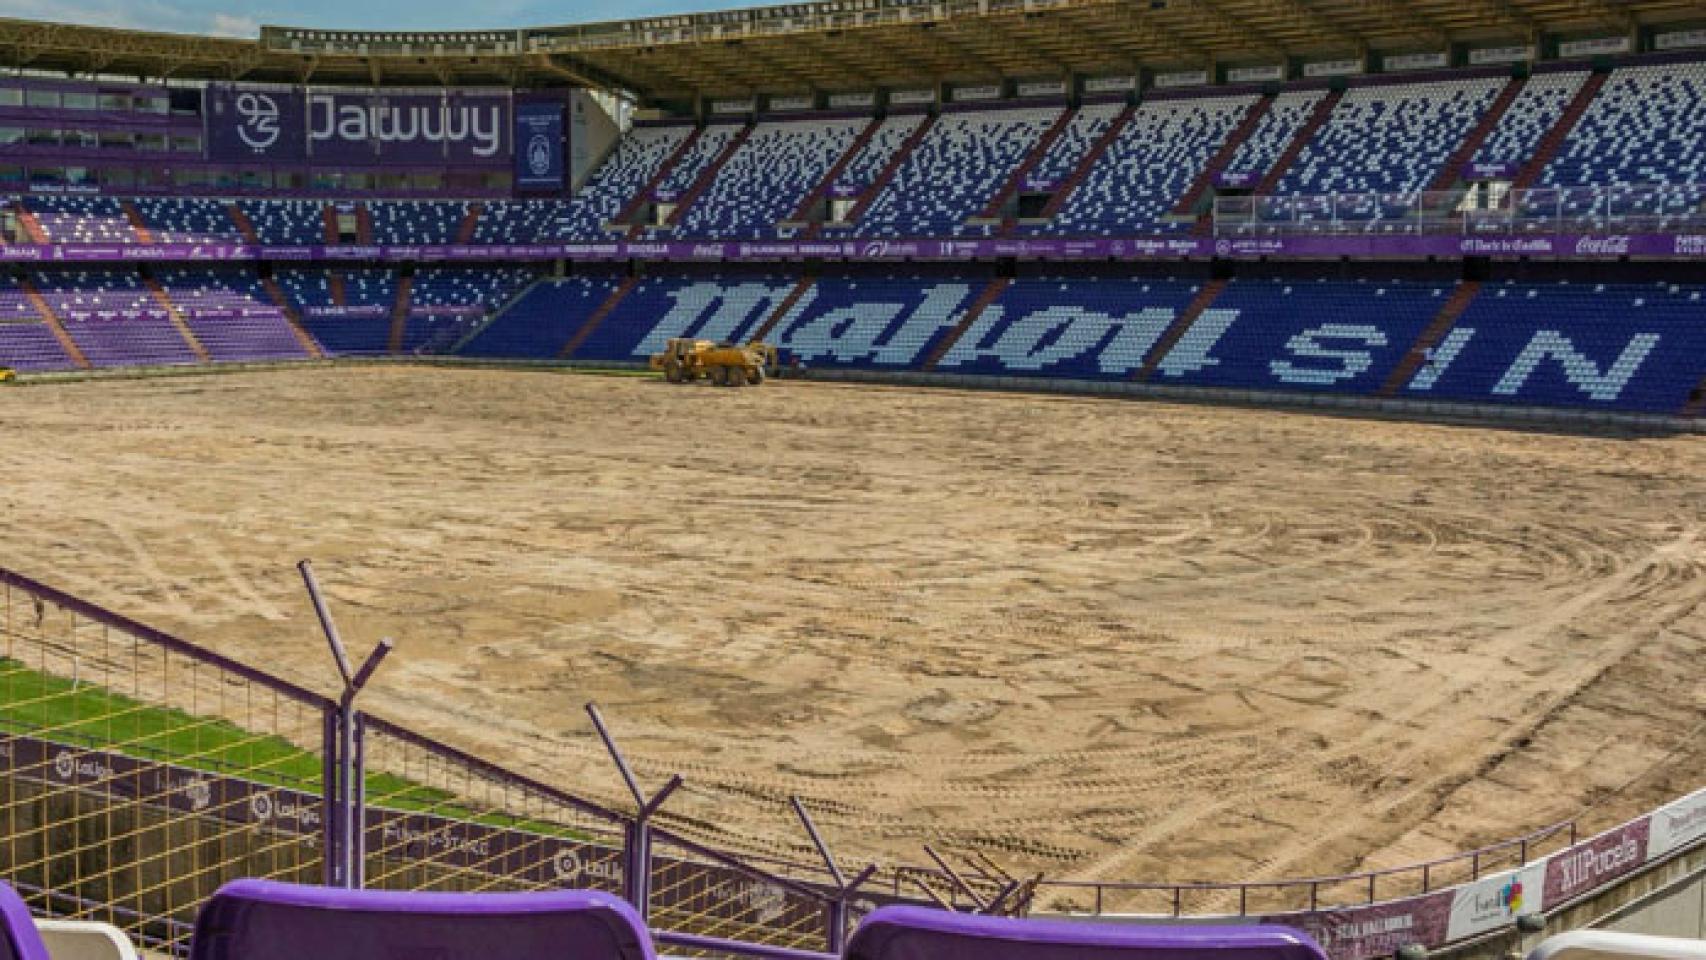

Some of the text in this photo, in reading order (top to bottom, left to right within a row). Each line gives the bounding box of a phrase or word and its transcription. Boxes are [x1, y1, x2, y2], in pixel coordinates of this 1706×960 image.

[309, 94, 500, 156] Jawwy
[630, 282, 1661, 400] Mahou SIN
